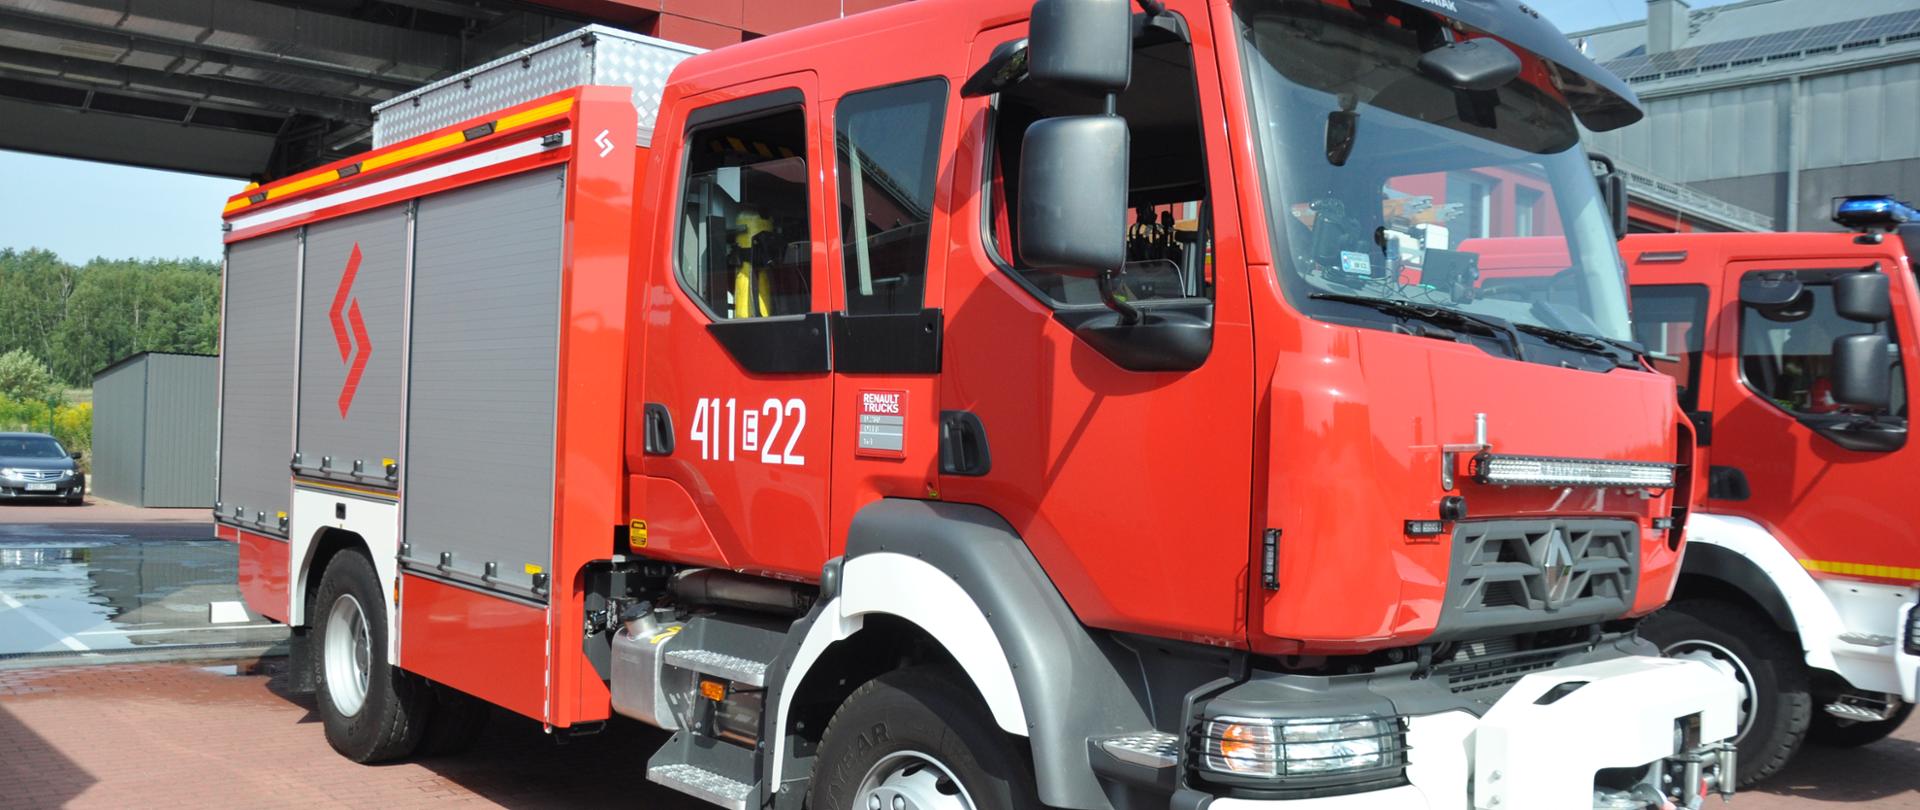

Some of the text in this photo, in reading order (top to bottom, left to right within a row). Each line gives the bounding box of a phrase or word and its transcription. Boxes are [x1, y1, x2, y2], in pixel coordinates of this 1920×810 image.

[863, 393, 900, 404] RENAULT
[863, 402, 899, 414] TRUCKS
[690, 398, 736, 461] 411
[761, 398, 806, 465] 22
